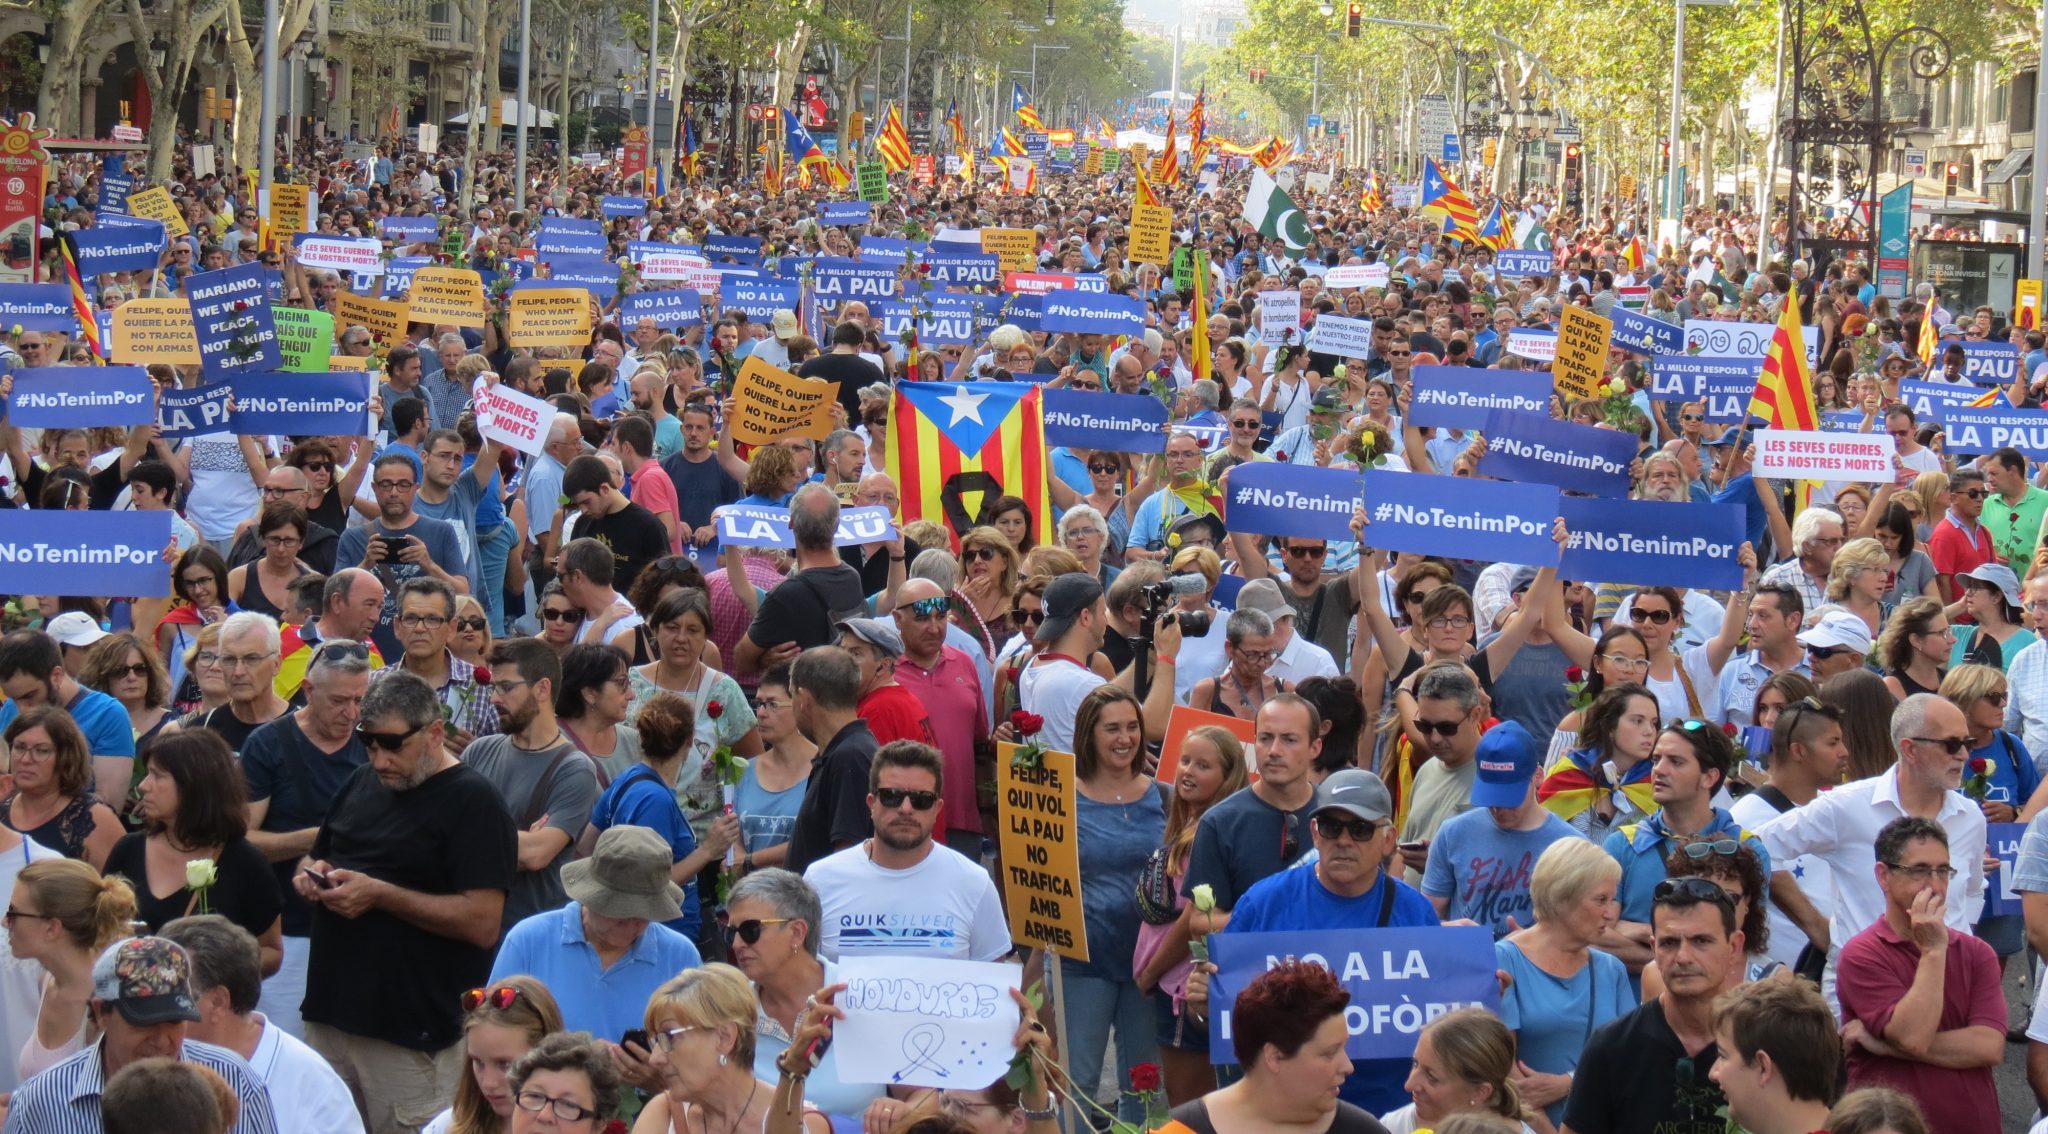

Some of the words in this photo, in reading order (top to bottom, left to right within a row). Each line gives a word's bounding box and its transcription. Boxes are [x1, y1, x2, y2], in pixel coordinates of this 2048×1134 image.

[1328, 120, 1336, 130] P
[11, 182, 22, 191] 19
[387, 227, 436, 235] #NoTenimPor
[320, 245, 342, 254] SEVES
[541, 243, 603, 256] #NoTenimPor
[704, 244, 757, 255] #NoTenimPor
[1133, 253, 1163, 261] WEAPONS
[304, 252, 317, 260] ELS
[318, 254, 351, 264] NOSTRES
[352, 257, 377, 266] MORTS
[1497, 259, 1516, 272] LA
[1520, 260, 1551, 273] PAU
[416, 275, 446, 285] FELIPE,
[447, 277, 479, 286] PEOPLE
[858, 269, 895, 277] RESPOSTA
[957, 267, 996, 282] PAU
[192, 277, 262, 300] MARIANO,
[423, 286, 444, 295] WHO
[446, 287, 471, 297] WANT
[815, 277, 843, 294] LA
[850, 277, 895, 296] PAU
[418, 296, 446, 306] PEACE
[517, 297, 548, 307] FELIPE,
[549, 296, 582, 305] PEOPLE
[635, 299, 653, 309] NO
[656, 297, 665, 307] A
[667, 296, 682, 306] LA
[736, 291, 756, 301] NO
[759, 292, 767, 301] A
[770, 292, 785, 302] LA
[126, 307, 164, 315] FELIPE,
[197, 304, 222, 318] WE
[447, 308, 483, 319] WEAPONS
[525, 307, 547, 316] WHO
[549, 306, 575, 316] WANT
[1048, 305, 1145, 324] #NoTenimPor
[124, 318, 162, 327] QUIERE
[164, 319, 177, 327] LA
[381, 321, 398, 330] PAZ
[522, 318, 550, 327] PEACE
[552, 317, 578, 327] DON'T
[922, 318, 971, 340] PAU
[1570, 313, 1604, 334] FELIPE,
[1624, 317, 1644, 332] NO
[1656, 328, 1671, 341] LA
[131, 331, 145, 340] NO
[148, 331, 194, 340] TRAFICA
[297, 326, 318, 339] QUE
[512, 329, 535, 338] DEAL
[536, 329, 546, 337] IN
[548, 328, 589, 337] WEAPONS
[1322, 331, 1352, 341] NUESTROS
[1349, 326, 1369, 334] MIEDO
[1566, 324, 1582, 338] QUI
[1584, 330, 1603, 345] VOL
[131, 344, 150, 352] CON
[153, 343, 194, 352] ARMAS
[1515, 340, 1528, 348] LES
[1529, 340, 1551, 349] SEVES
[1565, 336, 1577, 346] LA
[1578, 340, 1601, 355] PAU
[1571, 349, 1586, 362] NO
[1974, 349, 2014, 358] RESPOSTA
[1558, 356, 1597, 378] TRAFICA
[1654, 363, 1666, 371] LA
[1667, 364, 1701, 373] MILLOR
[1703, 366, 1748, 376] RESPOSTA
[1966, 358, 2015, 379] PAU
[1565, 371, 1586, 385] AMB
[1652, 373, 1685, 395] LA
[750, 372, 784, 397] FELIPE,
[786, 389, 822, 401] QUIEN
[1557, 379, 1590, 398] ARMES
[1903, 385, 1913, 393] LA
[1915, 387, 1949, 397] MILLOR
[16, 391, 145, 408] #NoTenimPor
[168, 394, 204, 407] MILLOR
[236, 397, 365, 413] #NoTenimPor
[743, 387, 779, 410] QUIERE
[780, 400, 796, 412] LA
[1417, 389, 1544, 412] #NoTenimPor
[1708, 395, 1743, 417] LA
[1902, 393, 1933, 416] LA
[487, 392, 540, 426] GUERRES,
[745, 404, 761, 418] NO
[159, 410, 195, 431] LA
[742, 419, 767, 435] CON
[1044, 411, 1159, 433] #NoTenimPor
[1946, 413, 1958, 422] LA
[1960, 414, 1998, 424] MILLOR
[1999, 417, 2048, 426] RESPOSTA
[493, 415, 537, 441] MORTS
[1946, 425, 1982, 448] LA
[1991, 426, 2048, 450] PAU
[1489, 436, 1625, 475] #NoTenimPor
[1765, 440, 1786, 452] LES
[1789, 441, 1826, 454] SEVES
[1829, 442, 1885, 457] GUERRES,
[1763, 455, 1785, 467] ELS
[1788, 456, 1841, 469] NOSTRES
[1844, 459, 1886, 472] MORTS
[1374, 502, 1548, 536] #NoTenimPor
[725, 516, 781, 542] LA
[1567, 530, 1734, 559] #NoTenimPor
[1010, 766, 1063, 793] FELIPE,
[1007, 787, 1033, 809] QUI
[1037, 793, 1067, 817] VOL
[1011, 814, 1030, 836] LA
[1033, 819, 1064, 843] PAU
[1026, 843, 1048, 866] NO
[1999, 840, 2020, 855] LA
[1009, 866, 1074, 898] TRAFICA
[1463, 851, 1531, 903] Fish
[1029, 896, 1061, 920] AMB
[840, 914, 955, 928] QUIKSILVER
[1023, 919, 1074, 948] ARMES
[1342, 951, 1370, 982] A
[1383, 949, 1430, 980] LA
